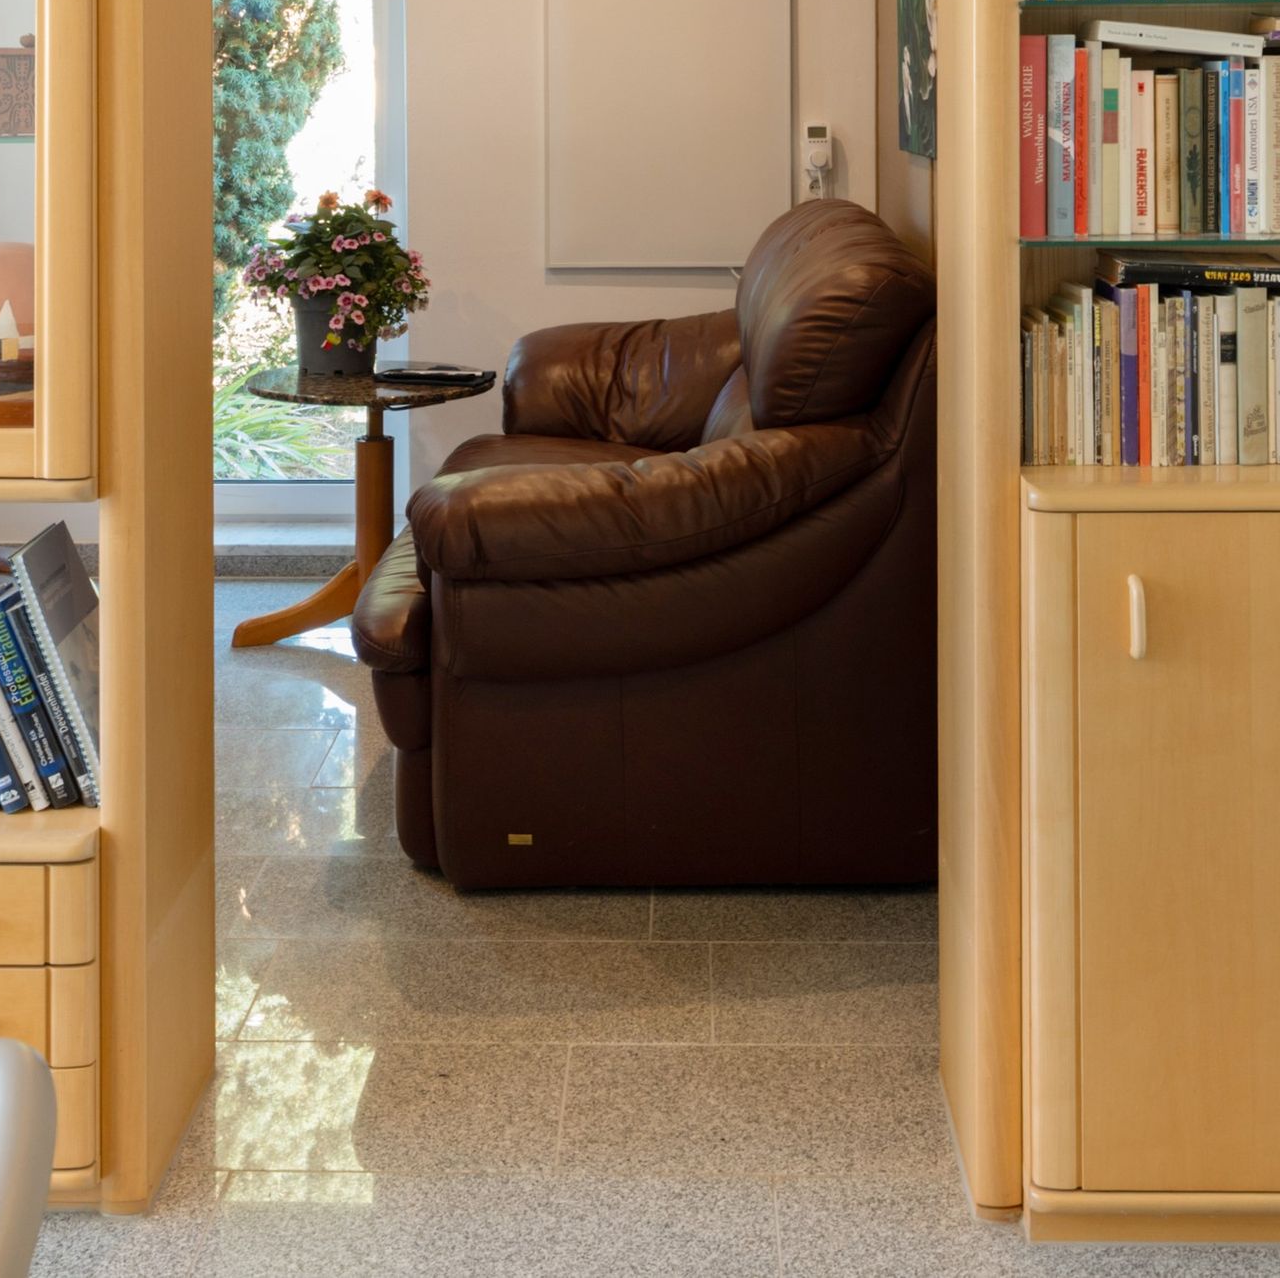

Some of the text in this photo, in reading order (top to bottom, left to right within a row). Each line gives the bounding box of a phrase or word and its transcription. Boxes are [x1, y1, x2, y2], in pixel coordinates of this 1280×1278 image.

[1022, 65, 1033, 138] WARIS DIRIE
[1062, 81, 1071, 182] MAFIA VON INNEN
[1034, 113, 1044, 185] Wüstenblume
[1247, 95, 1258, 172] Autorouten USA
[1136, 148, 1147, 217] FRANKENSTEIN
[1233, 163, 1241, 195] London
[1247, 179, 1258, 206] DUMONT
[1231, 272, 1252, 282] GOTT
[38, 672, 69, 734] Devisenhandel
[29, 729, 48, 767] Christian Eck
[41, 739, 55, 764] Matthias
